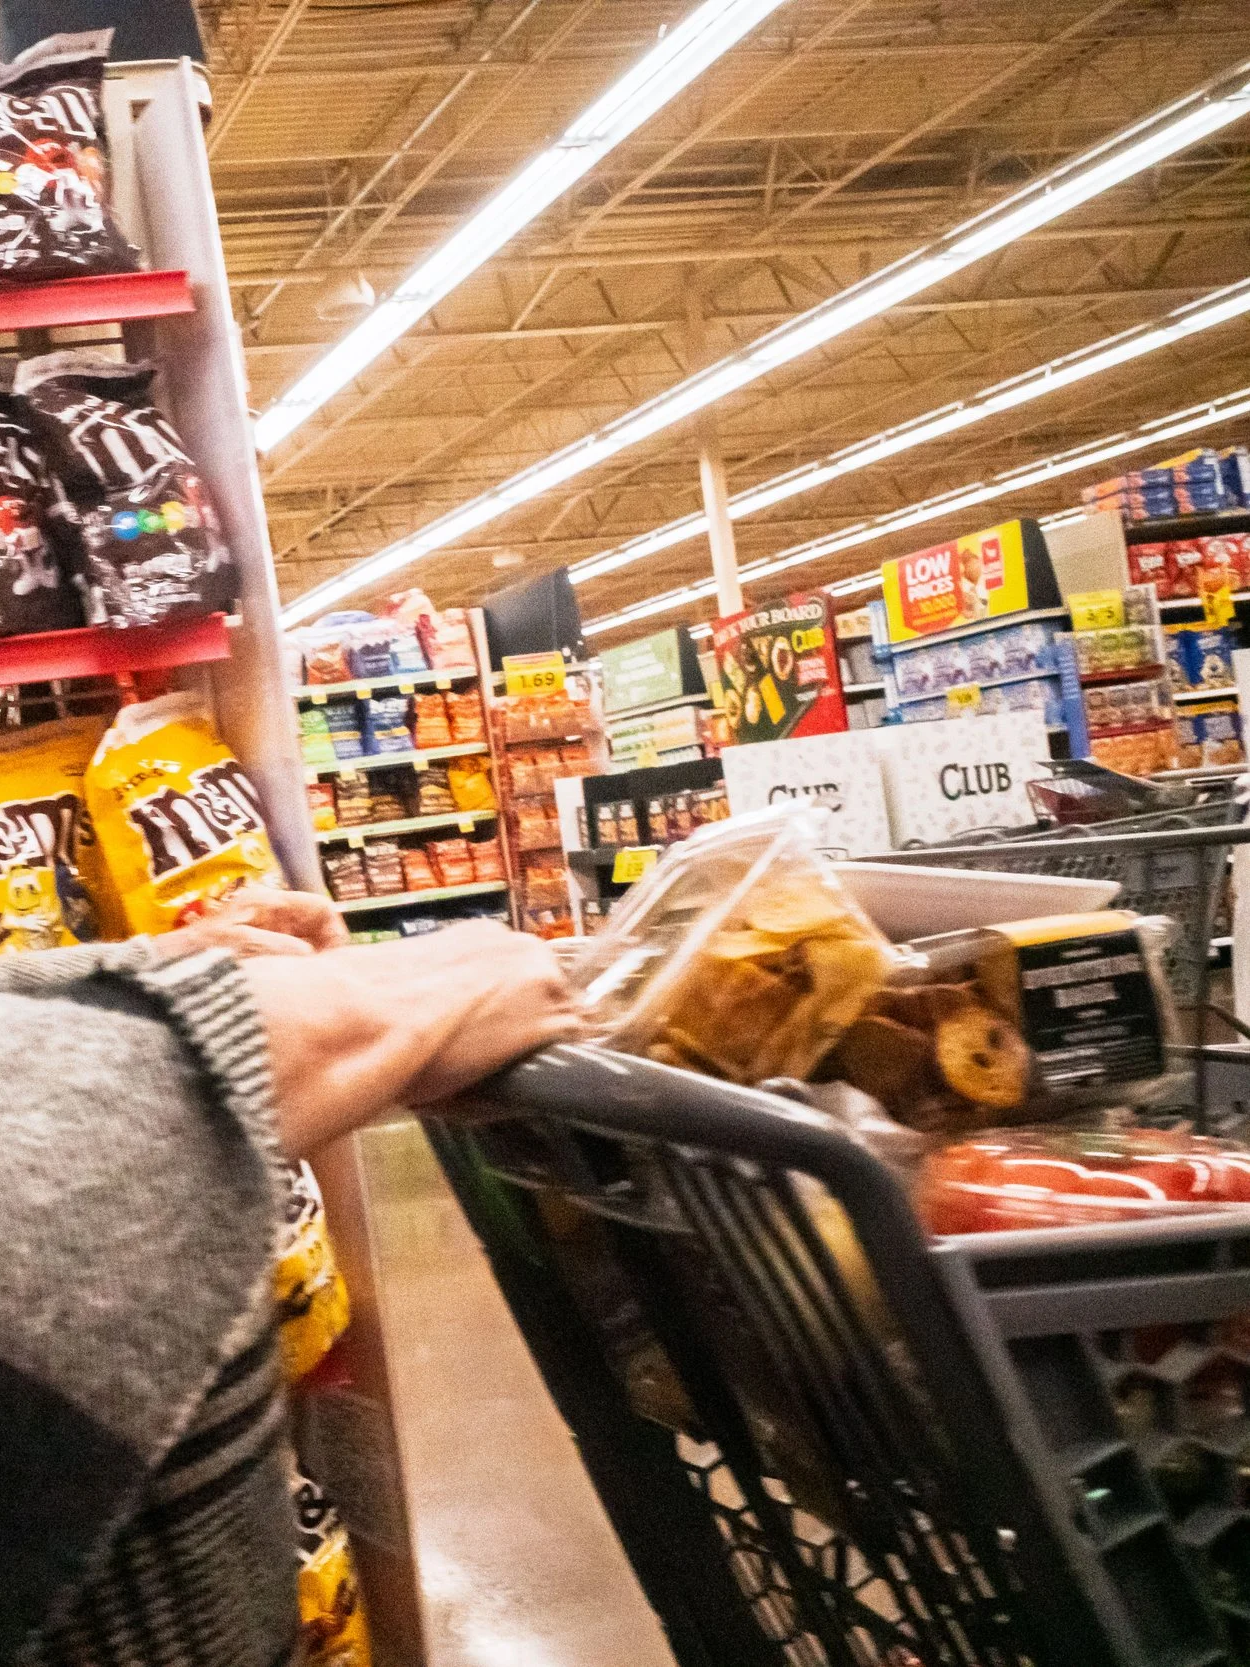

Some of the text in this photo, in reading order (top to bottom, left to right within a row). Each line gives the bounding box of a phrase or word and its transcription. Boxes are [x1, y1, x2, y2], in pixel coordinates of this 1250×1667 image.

[905, 551, 952, 585] LOW
[907, 575, 955, 604] PRICES
[519, 672, 556, 688] 1.69
[939, 762, 1012, 801] CLUB
